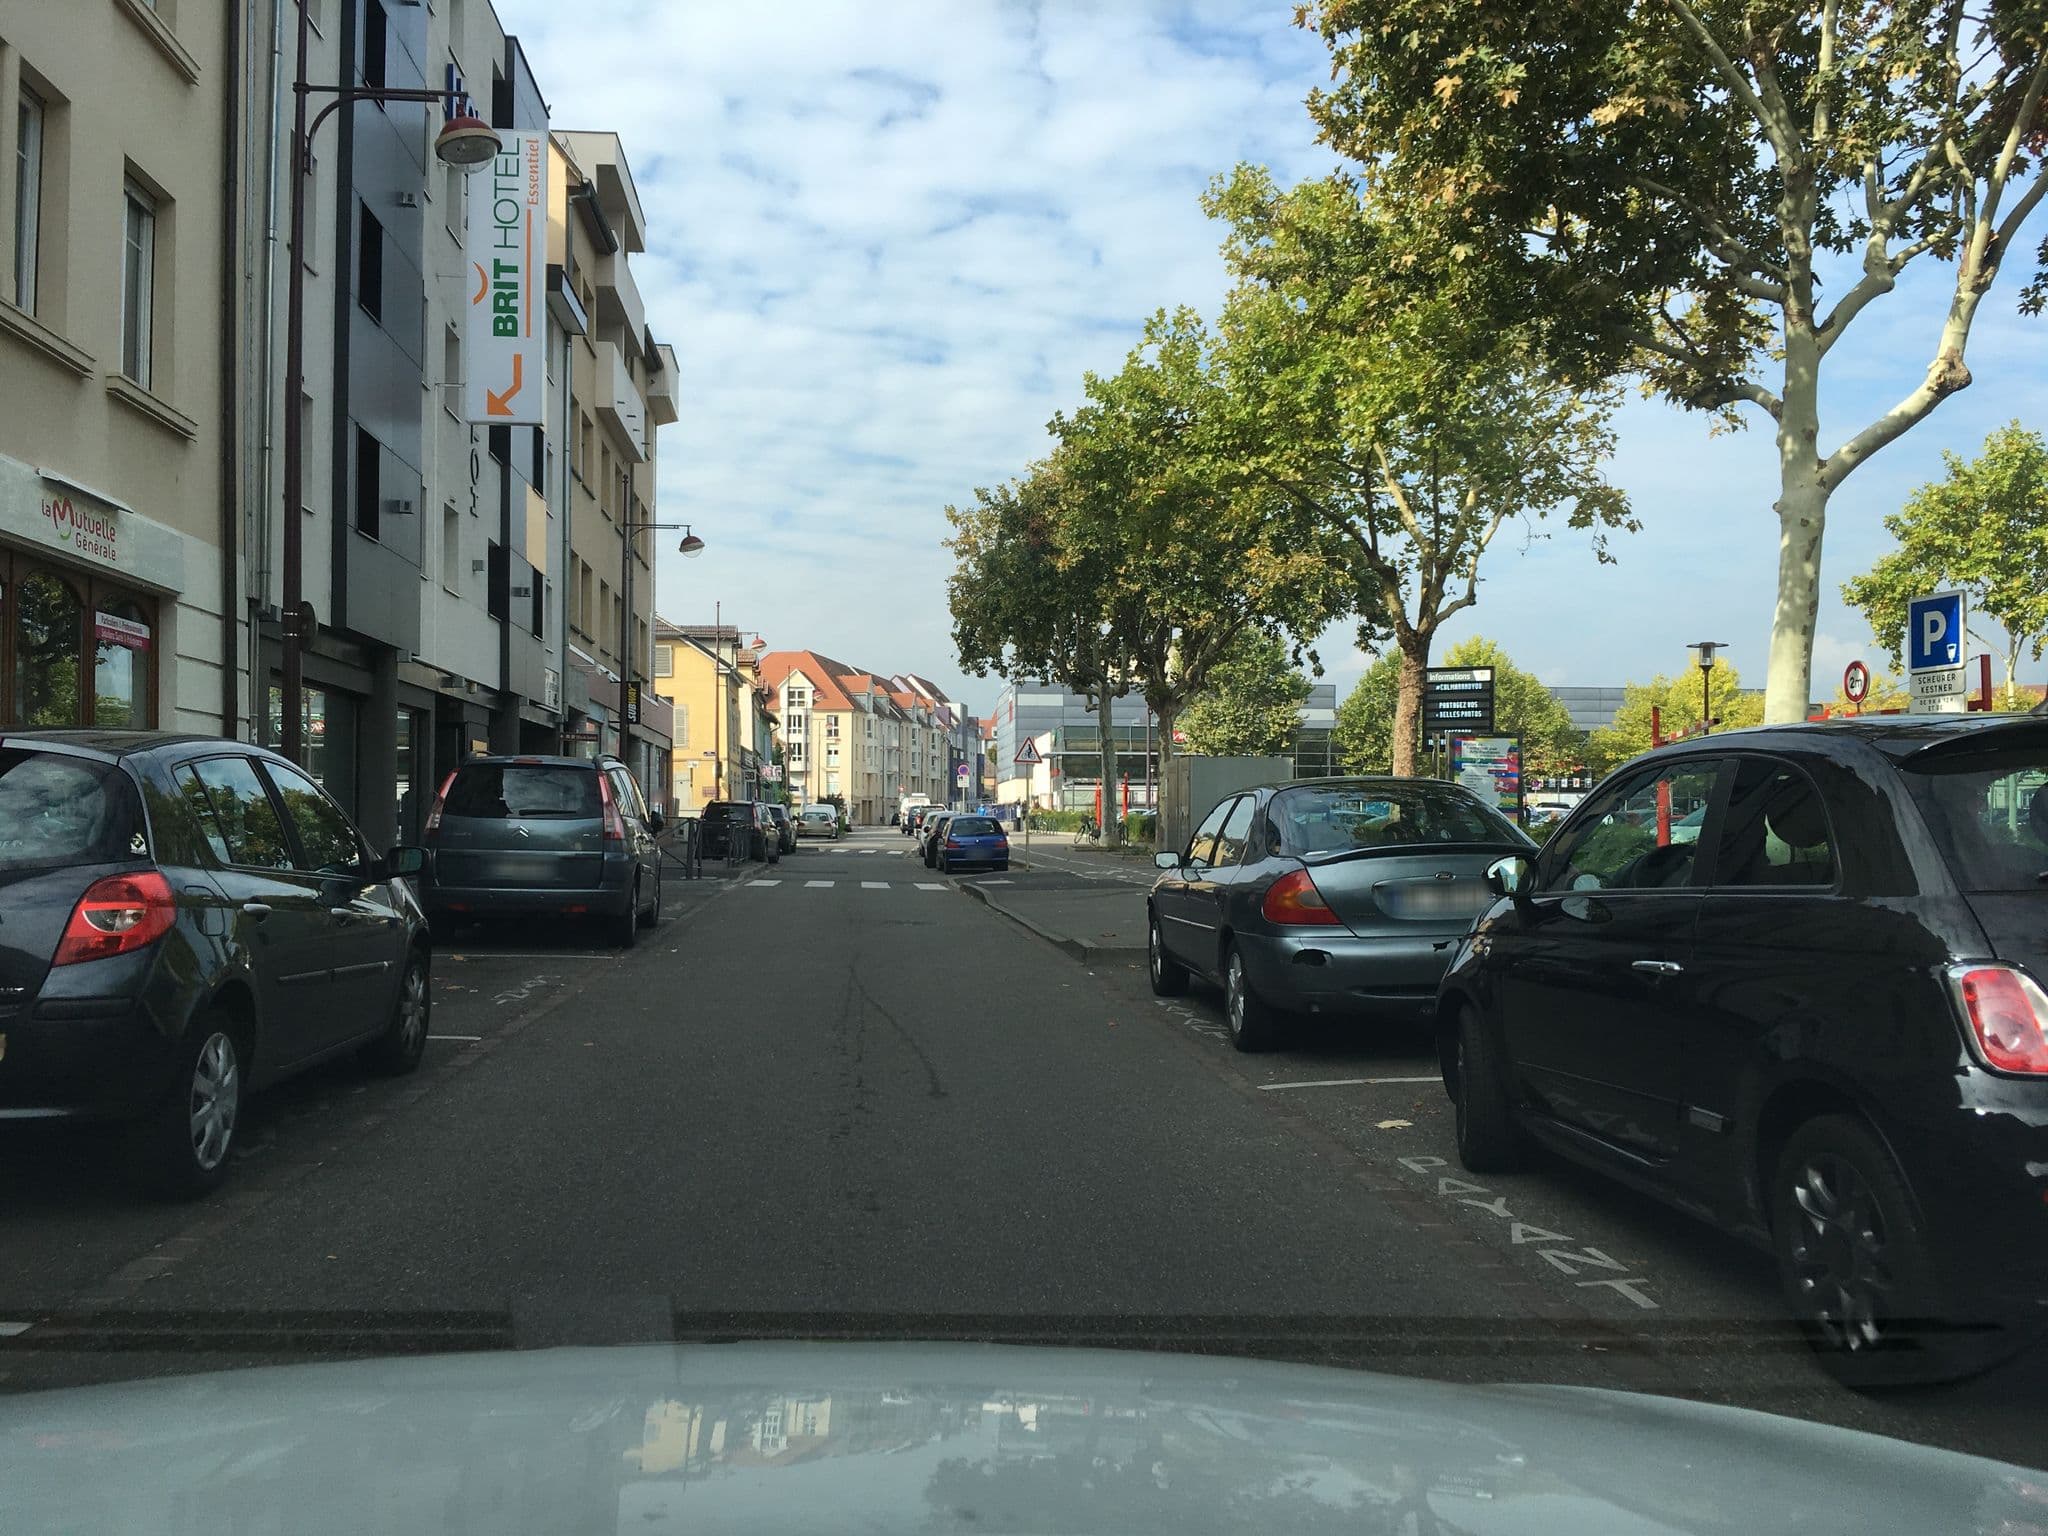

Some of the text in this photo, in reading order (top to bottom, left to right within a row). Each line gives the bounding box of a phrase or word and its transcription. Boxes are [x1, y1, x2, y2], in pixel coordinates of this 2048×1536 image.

[526, 139, 540, 206] Essentiel
[493, 137, 520, 337] BRIT HOTEL
[52, 497, 116, 543] Mutuelle
[75, 532, 117, 561] Générale
[1923, 610, 1947, 657] P
[1429, 672, 1471, 681] Informations
[1849, 676, 1863, 689] 2m
[1918, 673, 1957, 685] SCHEURER
[1920, 684, 1953, 694] KESTNER
[627, 682, 637, 723] SUBWAY
[1397, 1155, 1660, 1309] PAYANT
